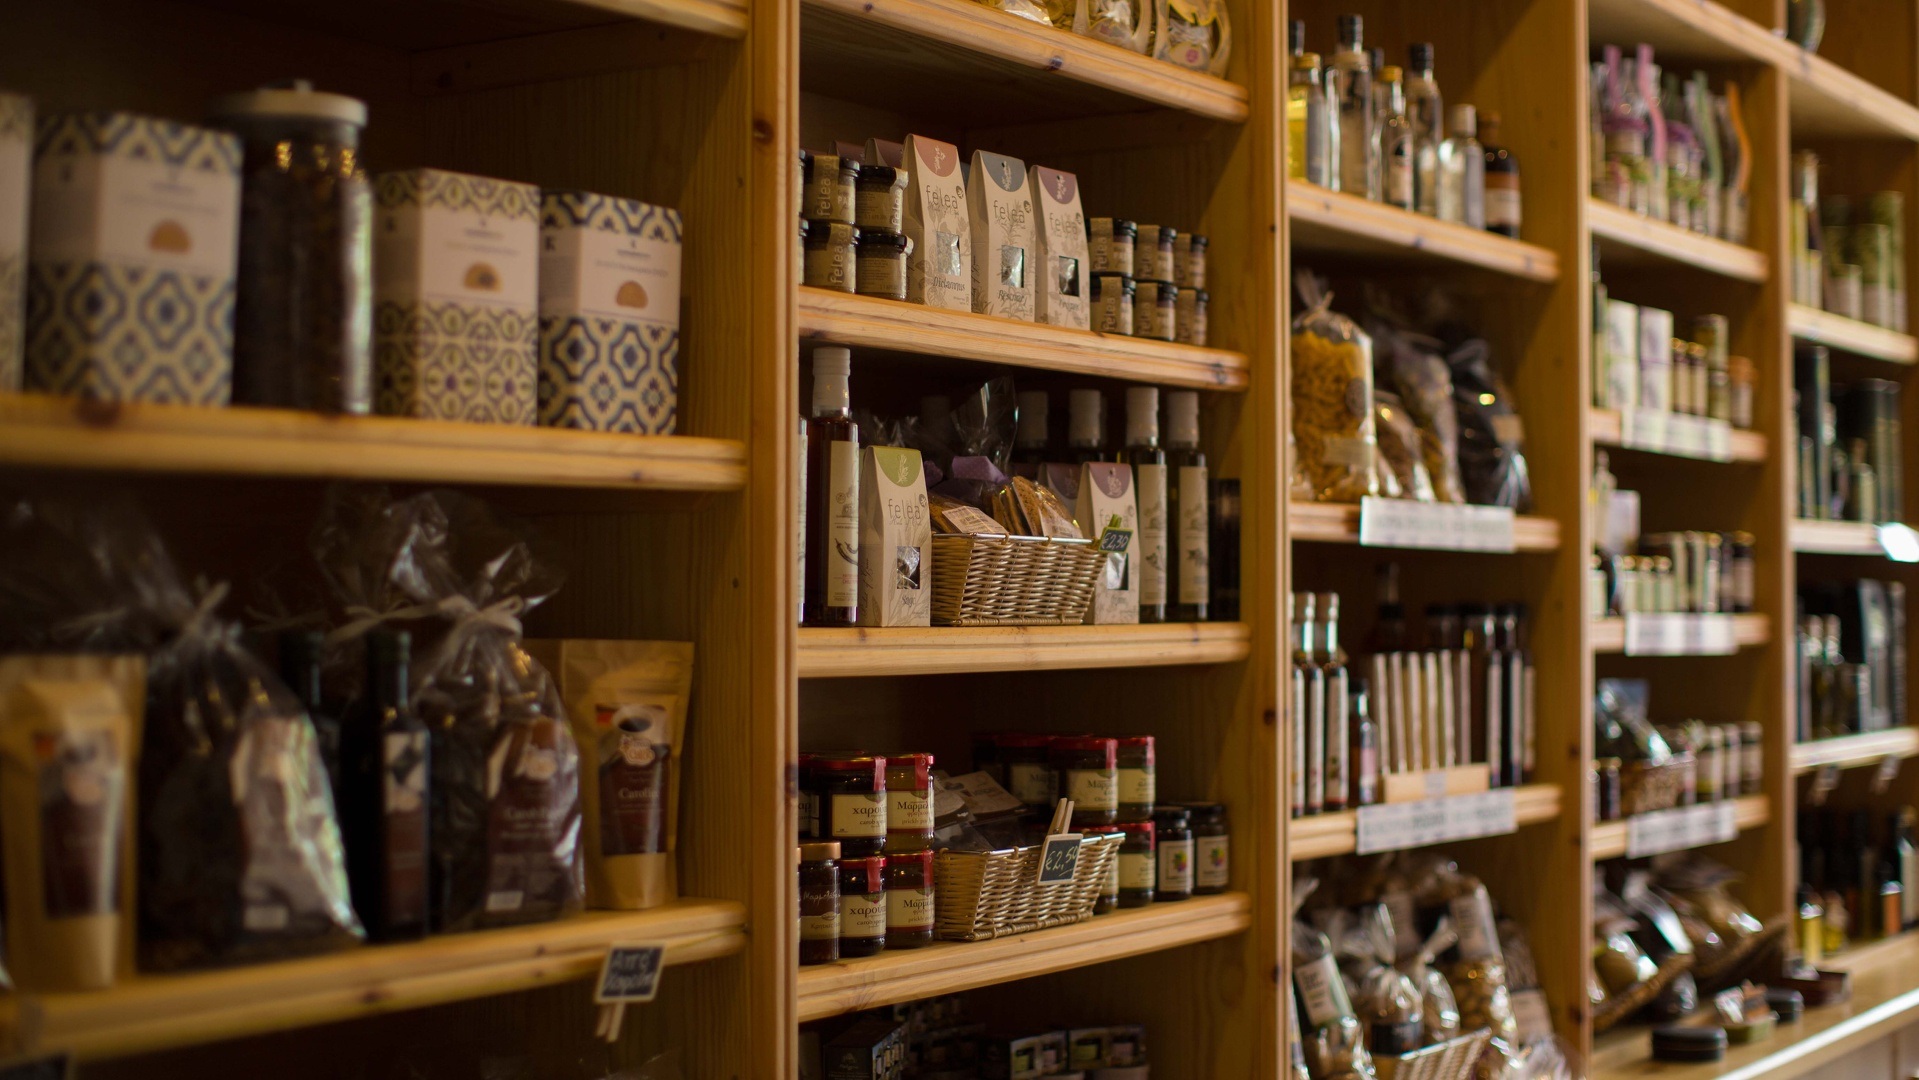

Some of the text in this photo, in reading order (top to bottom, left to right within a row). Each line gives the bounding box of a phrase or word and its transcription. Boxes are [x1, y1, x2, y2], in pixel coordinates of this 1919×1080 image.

[817, 176, 831, 216] felea
[926, 185, 958, 209] felea
[993, 200, 1025, 223] felea
[1049, 212, 1077, 234] felea
[831, 243, 844, 283] felea
[888, 499, 921, 520] felea
[1100, 508, 1130, 528] fea
